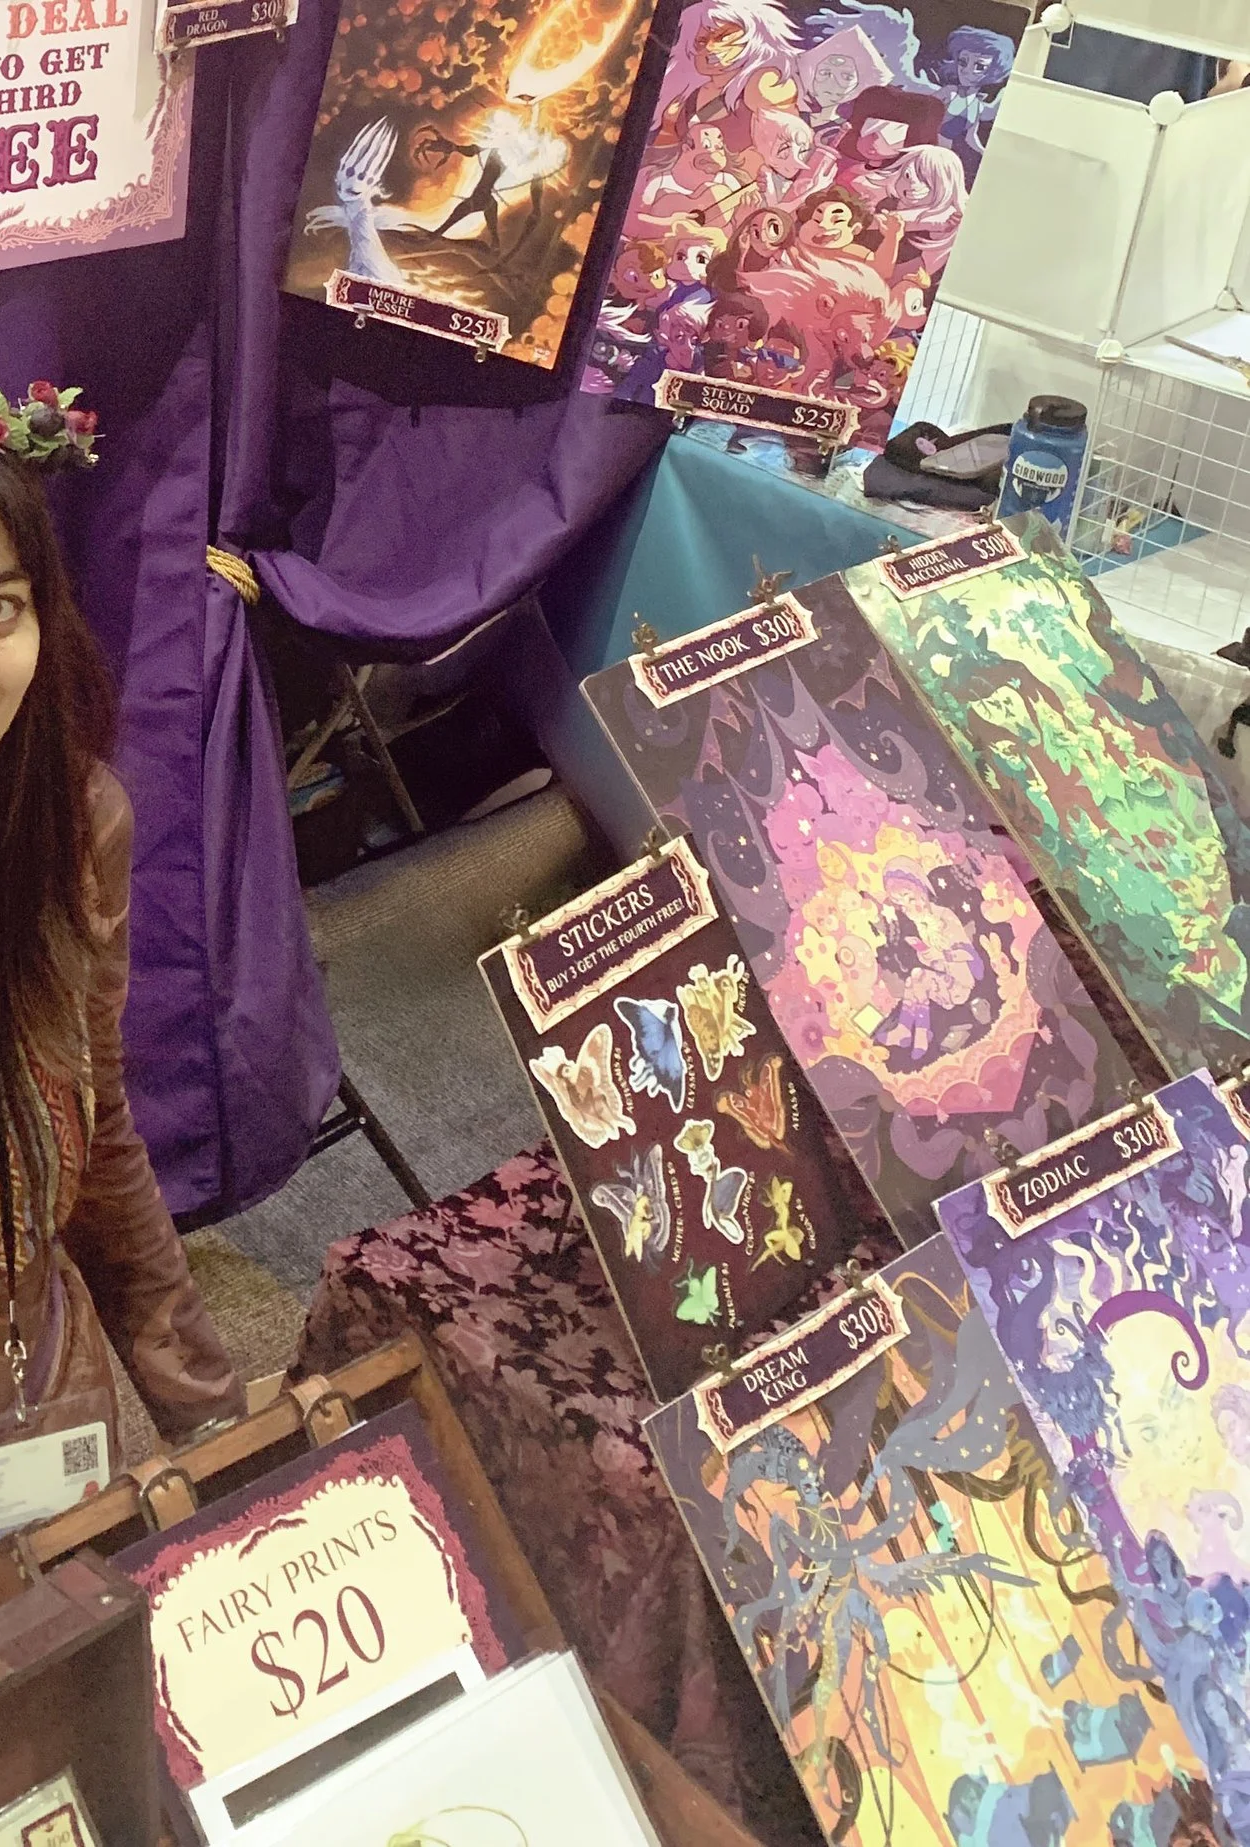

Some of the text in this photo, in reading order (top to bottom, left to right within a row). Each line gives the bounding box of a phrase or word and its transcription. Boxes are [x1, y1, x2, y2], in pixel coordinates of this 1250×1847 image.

[6, 0, 129, 41] DEAL
[186, 1, 277, 36] DRAGON $30
[198, 9, 219, 22] RED
[38, 42, 110, 75] GET
[368, 297, 486, 337] VESSEL $25
[369, 287, 415, 309] IMPURE
[701, 396, 832, 430] SQUAD $25
[702, 386, 755, 405] STEVEN
[1014, 463, 1066, 485] GIRDWOOD
[906, 535, 1004, 586] BACCHANAL $30
[908, 549, 949, 570] HIDDEN
[660, 614, 791, 684] THE NOOK $30
[558, 883, 654, 957] STICKERS
[545, 897, 686, 994] BUY 3 GET THE FOURTH FREE!
[790, 1096, 800, 1131] ATLAS
[1018, 1120, 1152, 1206] ZODIAC $30
[670, 1176, 683, 1209] CHILD
[671, 1217, 684, 1263] MOTHER
[743, 1347, 809, 1393] DREAM
[760, 1304, 878, 1406] KING $30
[176, 1509, 398, 1653] FAIRY PRINTS
[250, 1585, 386, 1720] $20
